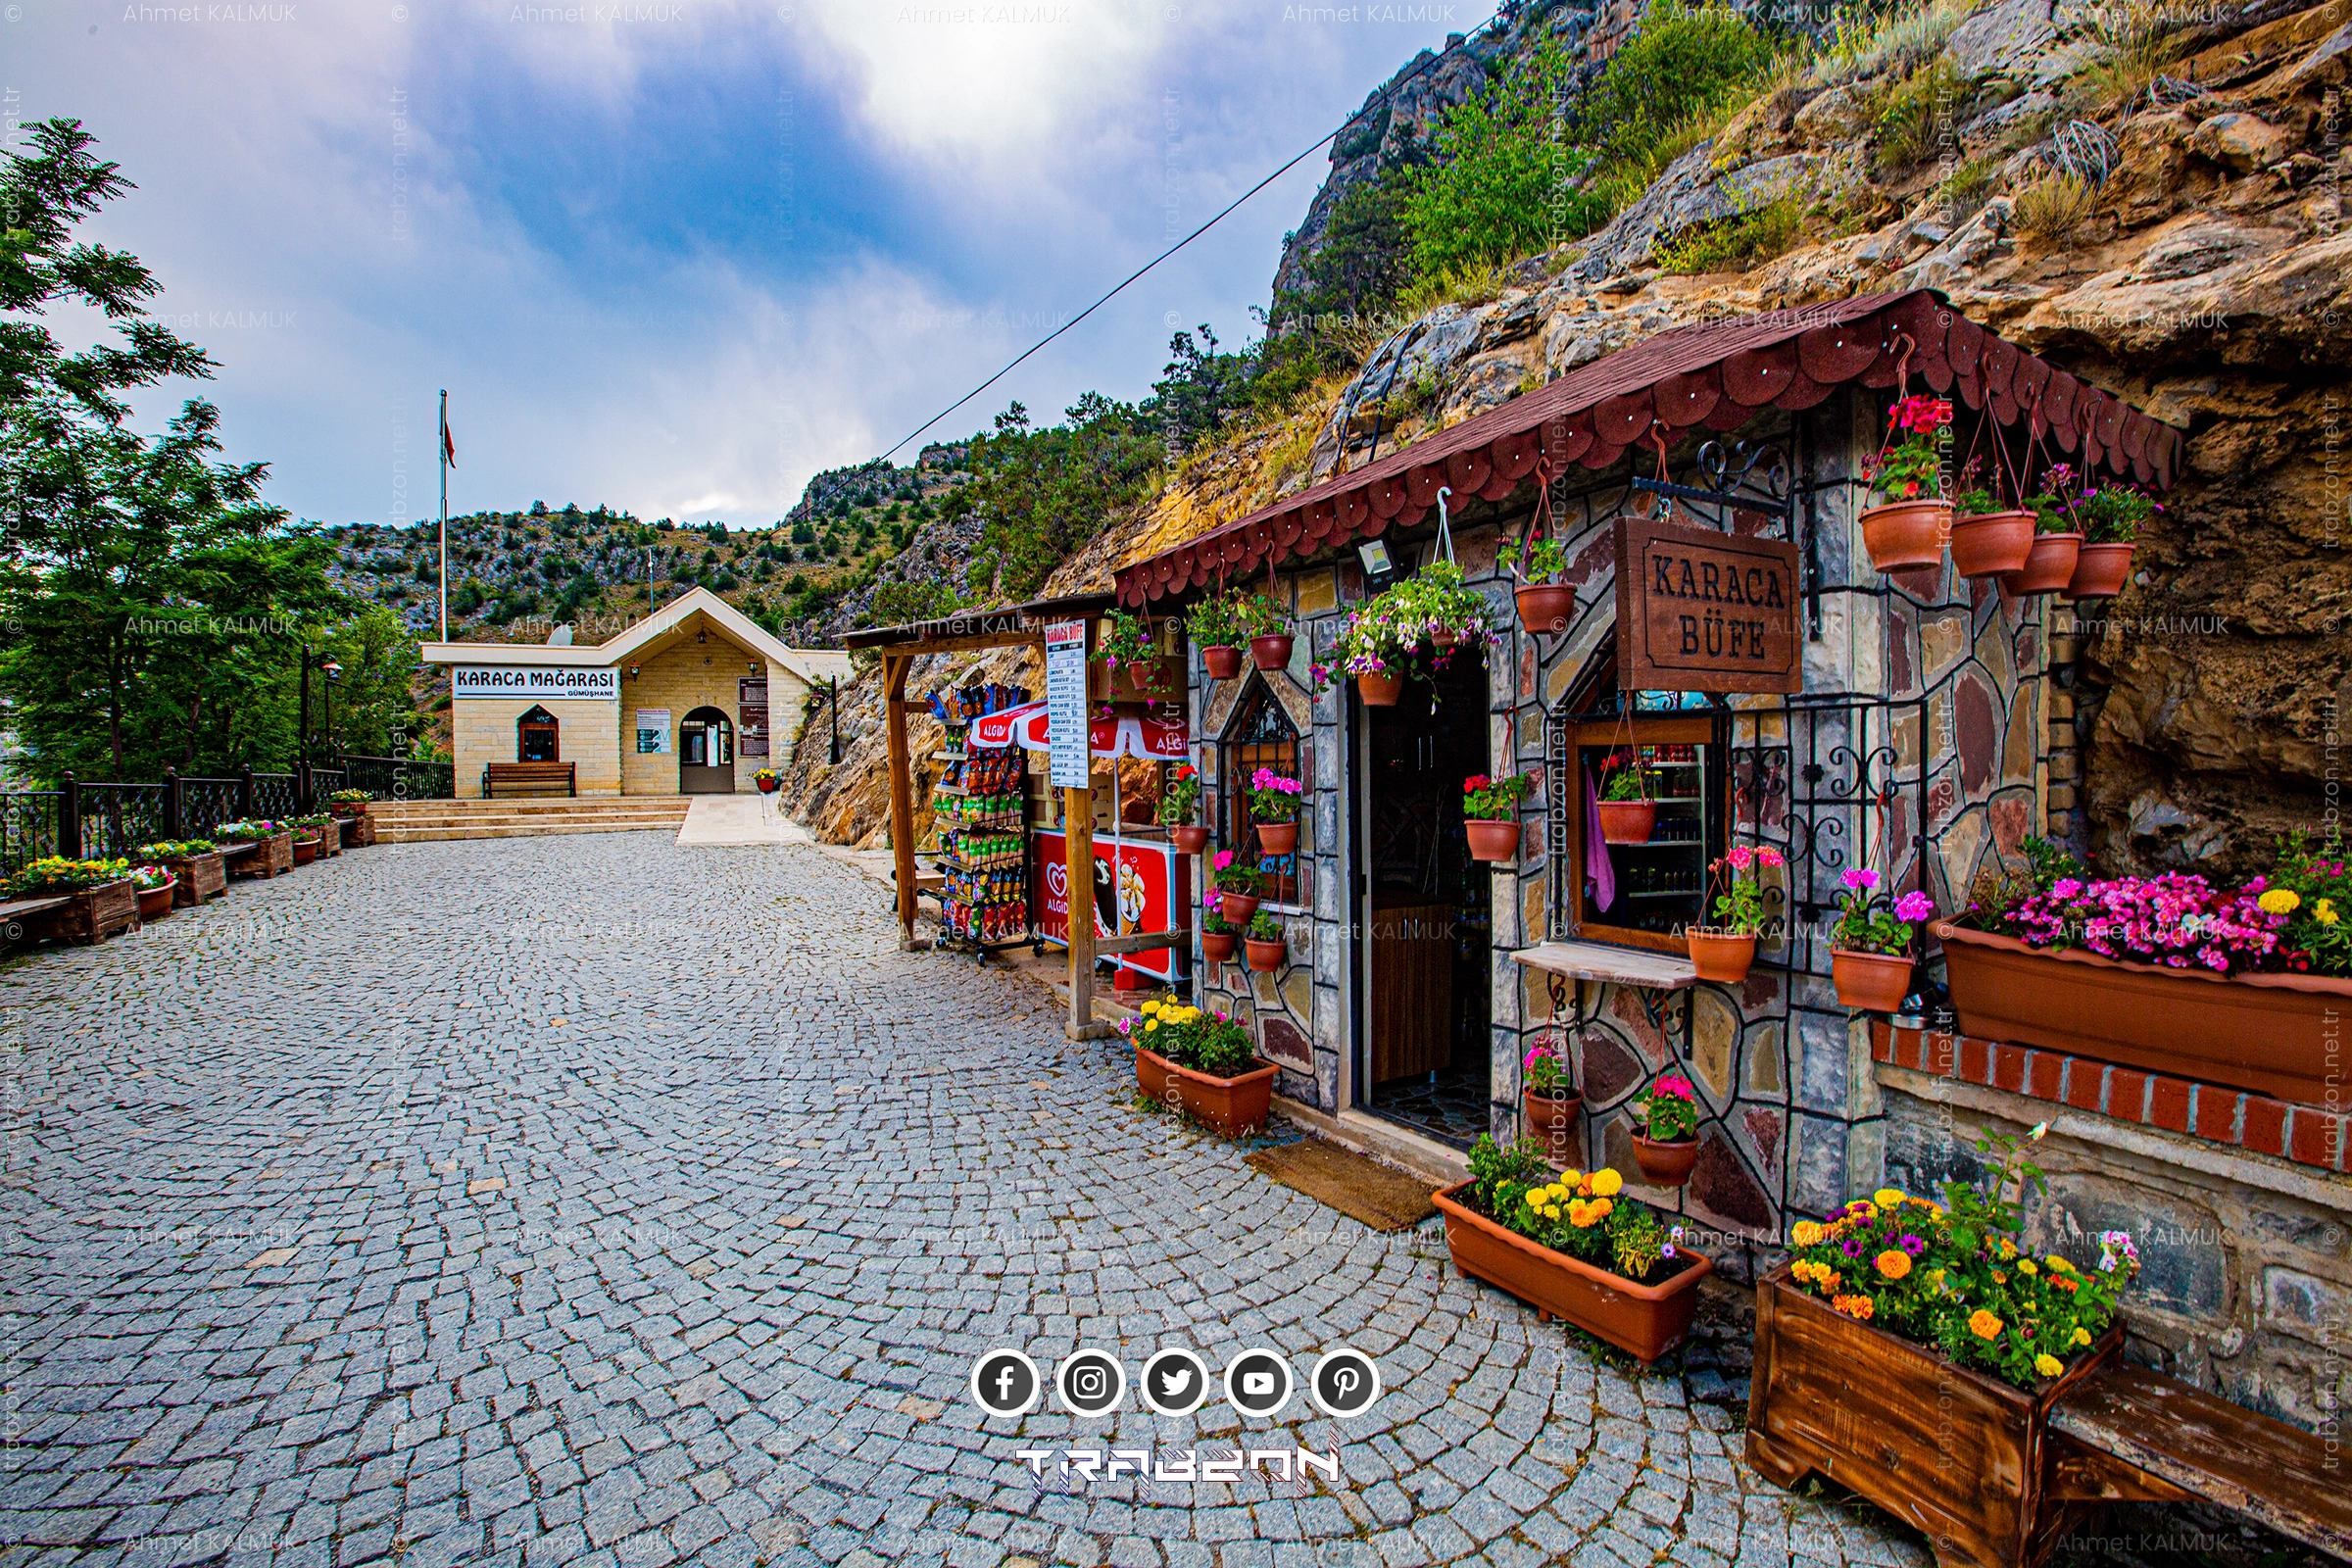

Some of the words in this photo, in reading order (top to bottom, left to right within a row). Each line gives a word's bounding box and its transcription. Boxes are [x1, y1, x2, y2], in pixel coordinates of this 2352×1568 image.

[1651, 554, 1786, 610] KARACA
[1679, 608, 1765, 661] BÜFE
[458, 671, 526, 686] KARACA
[530, 669, 614, 686] MAĞARASI
[984, 724, 1006, 737] ALGiD
[1156, 737, 1190, 751] ALGi
[1048, 899, 1068, 914] ALGiD
